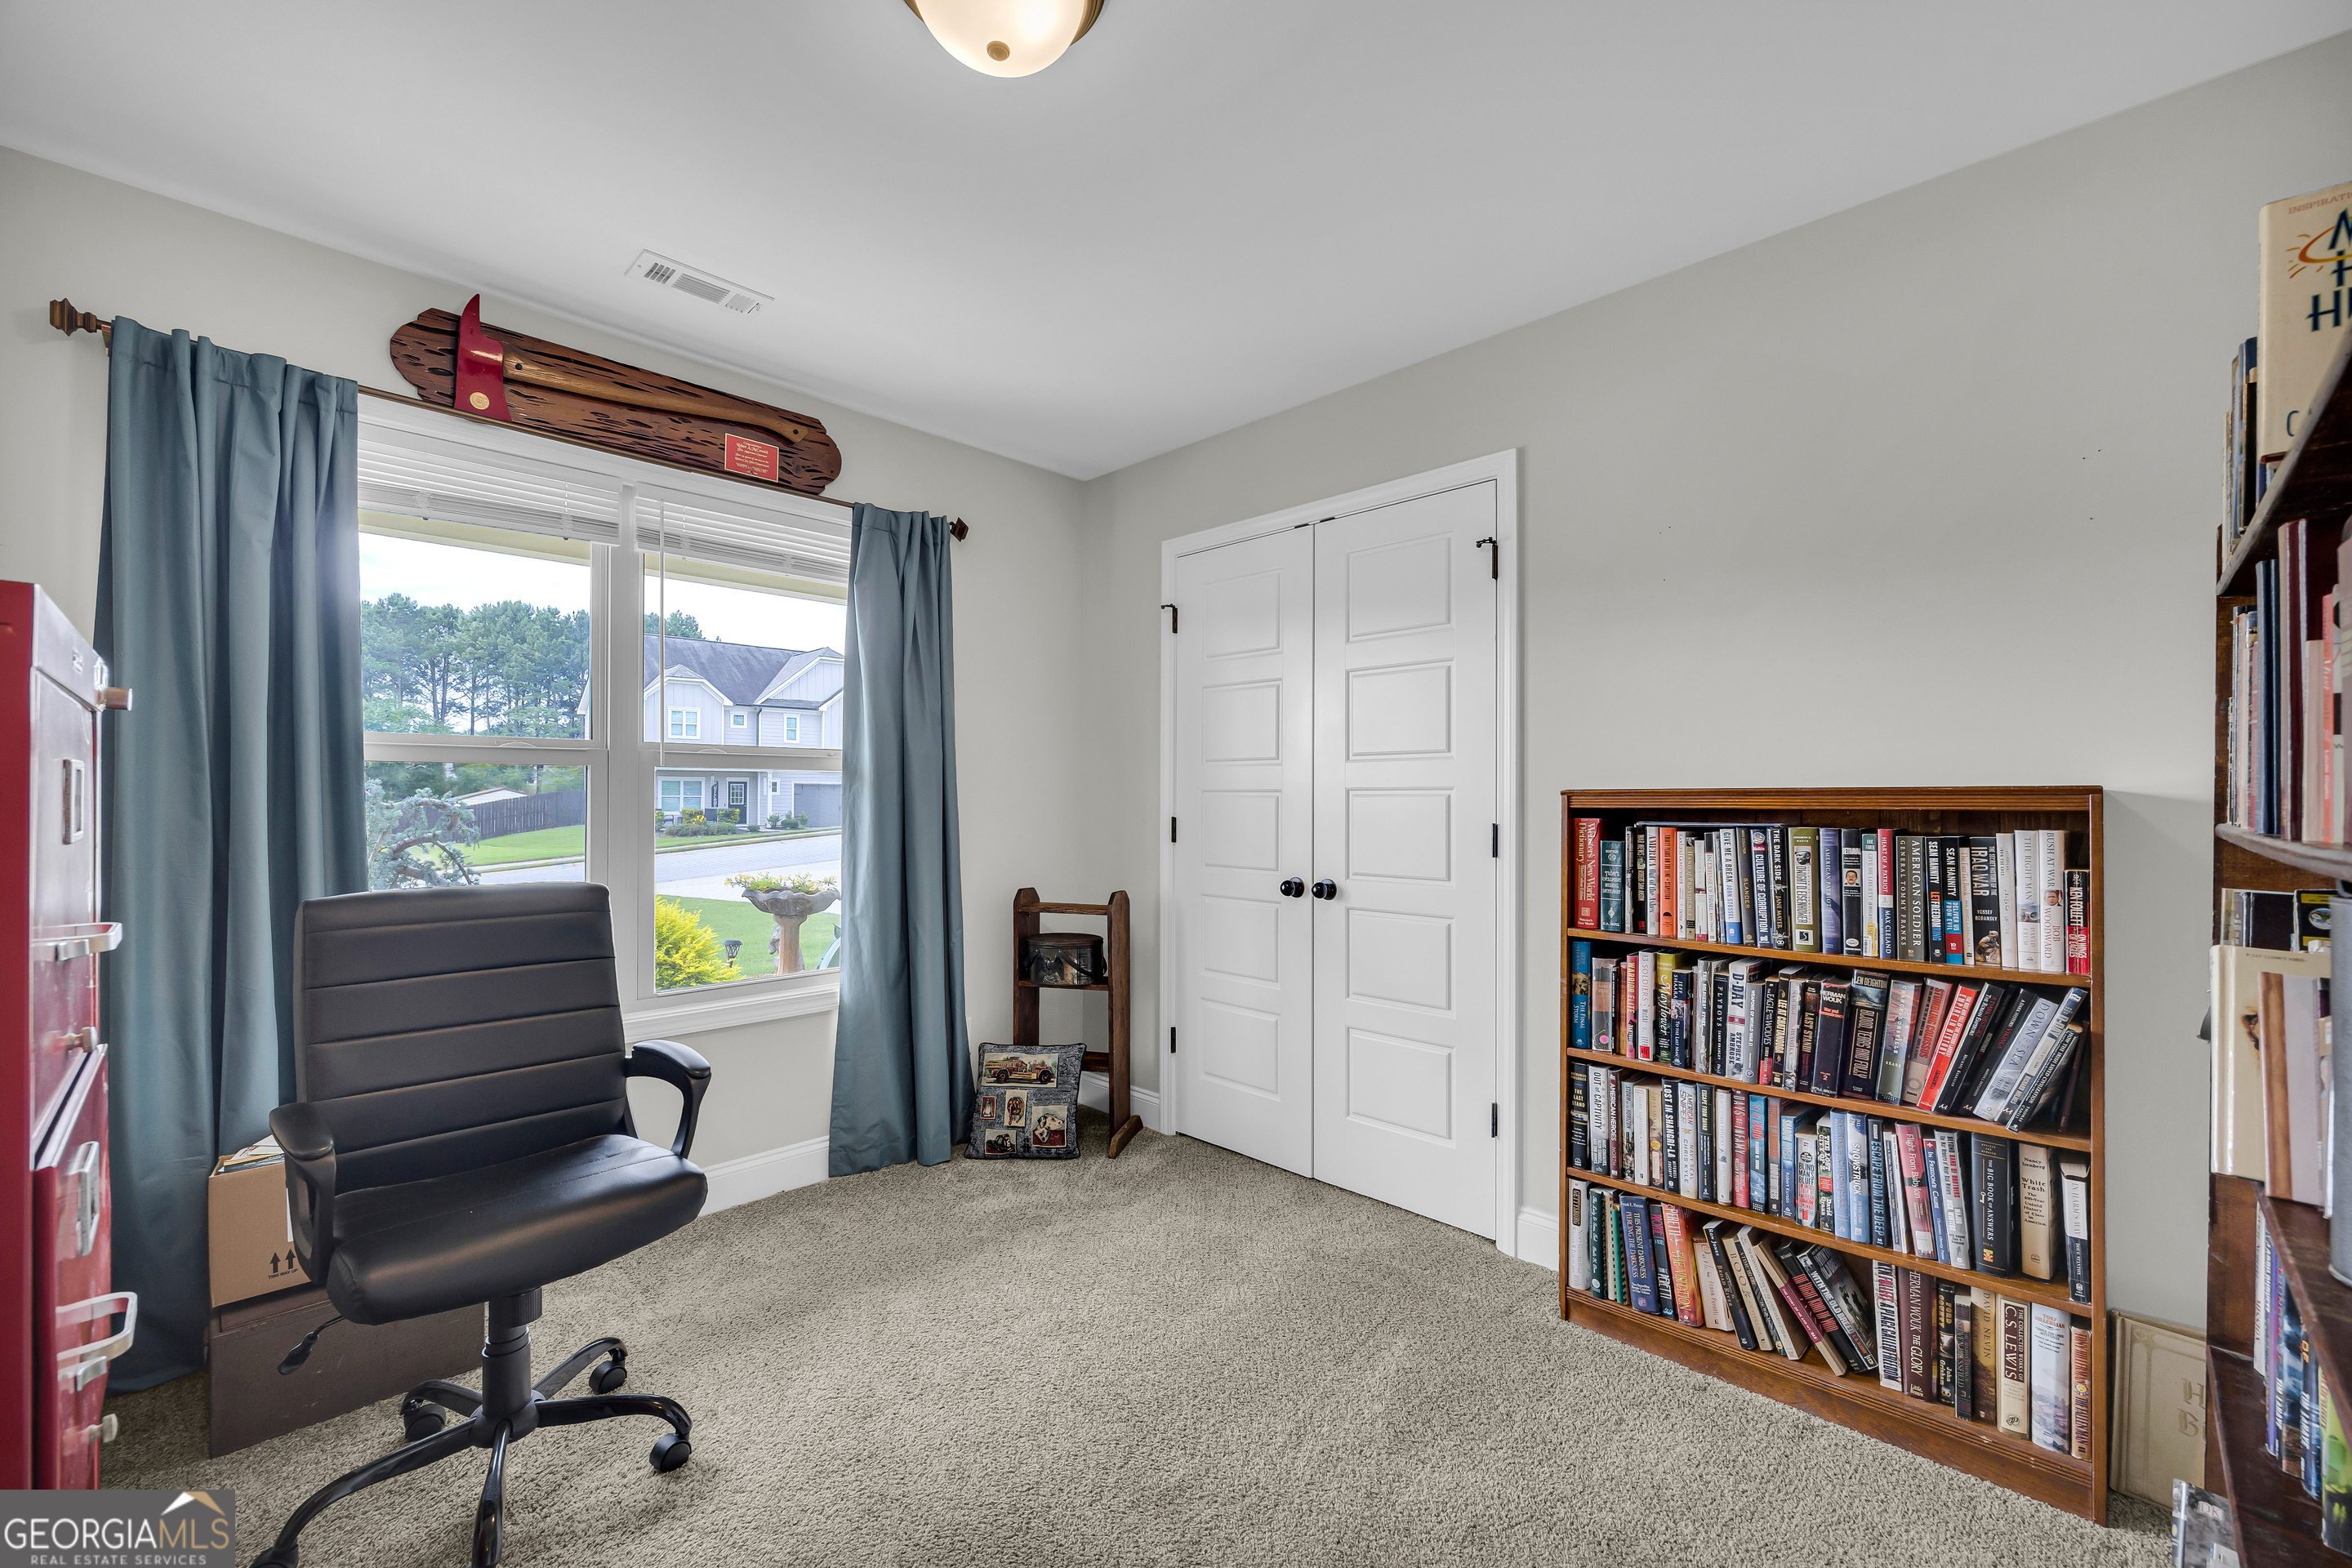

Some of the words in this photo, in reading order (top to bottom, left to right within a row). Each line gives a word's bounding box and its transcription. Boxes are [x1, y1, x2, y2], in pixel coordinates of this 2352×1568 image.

[2288, 191, 2352, 214] INSPIRATI
[1576, 822, 1587, 864] Dictionary
[1587, 822, 1596, 858] Webster's
[1723, 831, 1731, 845] GIVE
[1929, 841, 1938, 857] SEAN
[2047, 832, 2055, 854] BUSH
[1724, 848, 1731, 857] ME
[1946, 848, 1955, 865] SEAN
[1971, 847, 1988, 871] IRAQ
[2047, 857, 2055, 867] AT
[1587, 859, 1596, 876] New
[1725, 864, 1733, 883] BREAK
[1755, 854, 1764, 883] CULTURE
[1912, 840, 1921, 897] AMERICAN
[1929, 858, 1940, 884] HANNITY
[2047, 868, 2056, 888] WAR
[1587, 877, 1595, 902] World
[1757, 884, 1765, 892] OF
[1947, 866, 1956, 896] HANNITY
[1972, 873, 1989, 896] WAR
[2069, 887, 2083, 900] KEN
[1757, 893, 1768, 933] CORRUPTION
[1912, 900, 1922, 947] SOLDIER
[2070, 900, 2083, 927] FOLLETT
[2043, 907, 2051, 959] WOODWARD
[2052, 925, 2060, 942] BOB
[1731, 973, 1744, 1009] D-DAY
[1822, 996, 1842, 1004] WOUK
[1927, 987, 1944, 1025] STUMBLING
[1952, 993, 1967, 1017] EMPIRE
[2025, 1002, 2051, 1038] DOWN
[1763, 1021, 1773, 1045] WOLVES
[1918, 1025, 1936, 1058] COLOSSUS
[1938, 1028, 1954, 1056] HISTORY
[2008, 1047, 2025, 1066] SEA
[1752, 1105, 1763, 1139] 5/5/2000
[1798, 1162, 1814, 1171] BLIND
[1871, 1140, 1882, 1172] ESCAPE
[1905, 1134, 1915, 1152] Flight
[1911, 1171, 1922, 1199] Babylon
[2021, 1161, 2046, 1169] Isenberg
[2024, 1156, 2042, 1165] Nancy
[1852, 1143, 1861, 1195] SNOWSTRUCK
[1798, 1176, 1814, 1186] BLUFF
[1872, 1174, 1883, 1196] FROM
[2021, 1177, 2047, 1187] White
[1873, 1199, 1883, 1214] THE
[2024, 1195, 2045, 1204] 400-Year
[2024, 1205, 2042, 1214] History
[2025, 1200, 2042, 1209] Untold
[1633, 1212, 1642, 1225] THIS
[1666, 1208, 1682, 1236] PERETTI
[1873, 1214, 1884, 1236] DEEP
[1635, 1225, 1644, 1250] PRESENT
[1711, 1241, 1720, 1256] JONES
[1637, 1250, 1646, 1279] DARKNESS
[1672, 1251, 1686, 1267] THE
[1674, 1269, 1691, 1312] VISITATION
[1717, 1265, 1726, 1285] BROAD
[1724, 1288, 1732, 1307] RIVER
[1811, 1271, 1825, 1289] WITH
[1821, 1287, 1833, 1300] THE
[1829, 1299, 1840, 1314] OLD
[1838, 1312, 1855, 1334] BREED
[2275, 1377, 2283, 1393] TIM
[2300, 1391, 2310, 1408] TIM
[2275, 1395, 2283, 1430] LAHAYE
[2300, 1410, 2310, 1450] LAHAYE
[2199, 1503, 2220, 1519] DK
